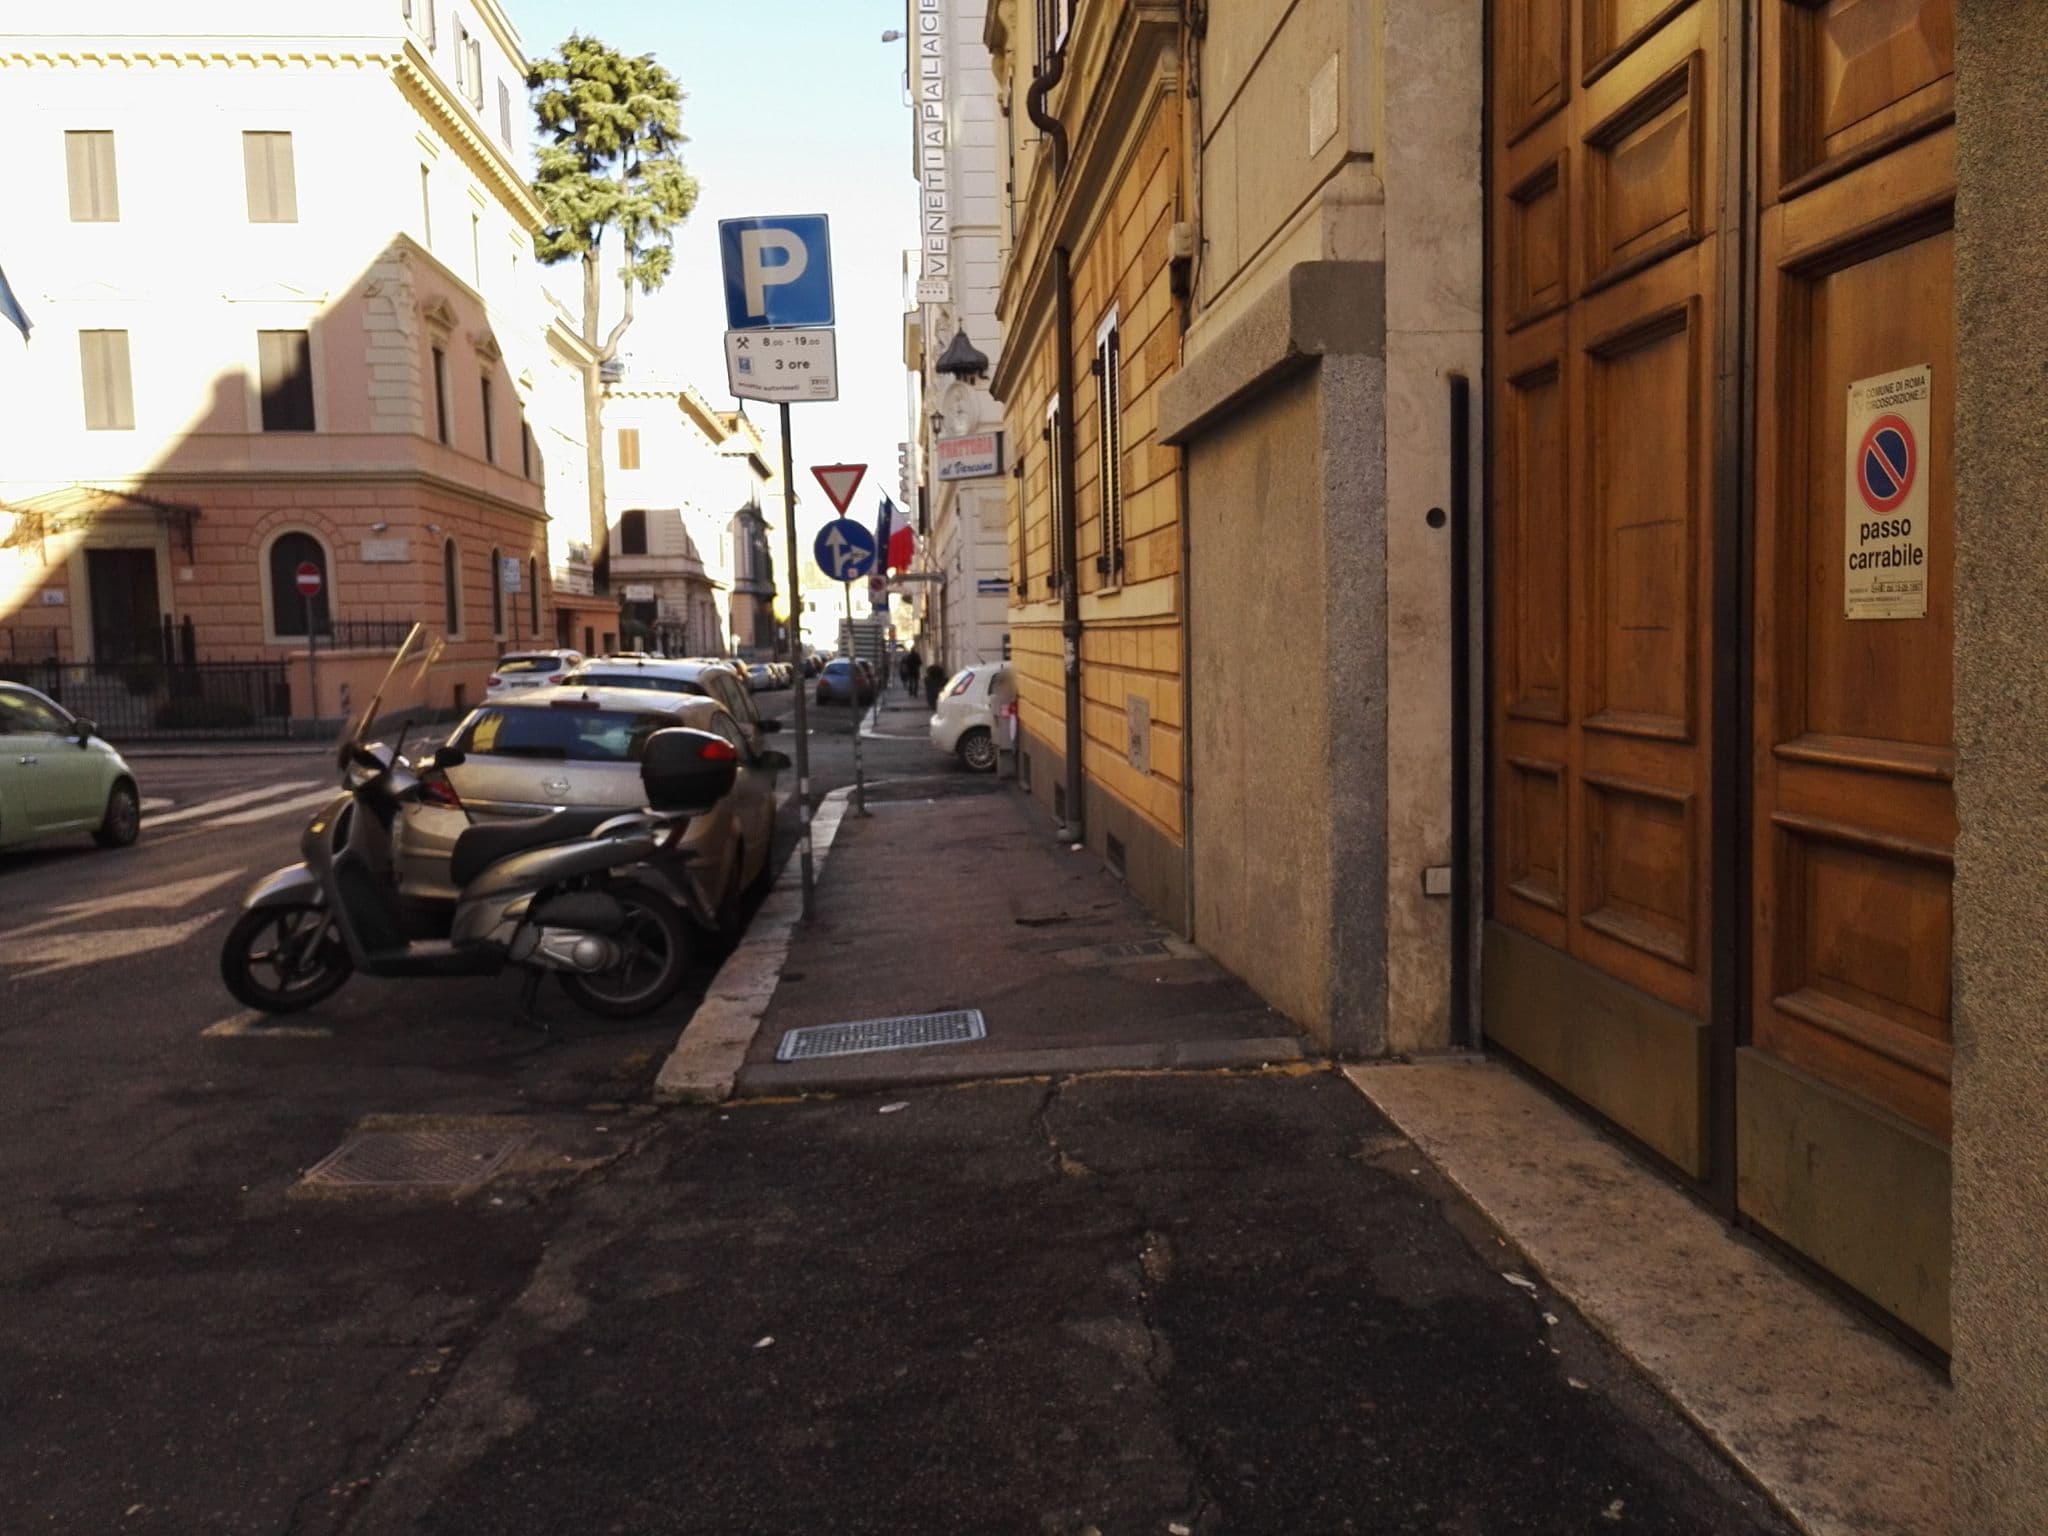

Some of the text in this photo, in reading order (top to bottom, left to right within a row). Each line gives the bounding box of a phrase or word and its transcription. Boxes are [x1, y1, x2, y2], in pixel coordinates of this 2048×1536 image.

[922, 0, 945, 273] VENETIA PALACE
[741, 228, 808, 318] P
[775, 359, 810, 369] 3 ore
[1866, 376, 1925, 399] COMUNE DI ROMA
[938, 435, 993, 459] TRATTORIA
[1861, 519, 1911, 546] passo
[1849, 543, 1923, 570] carrabile
